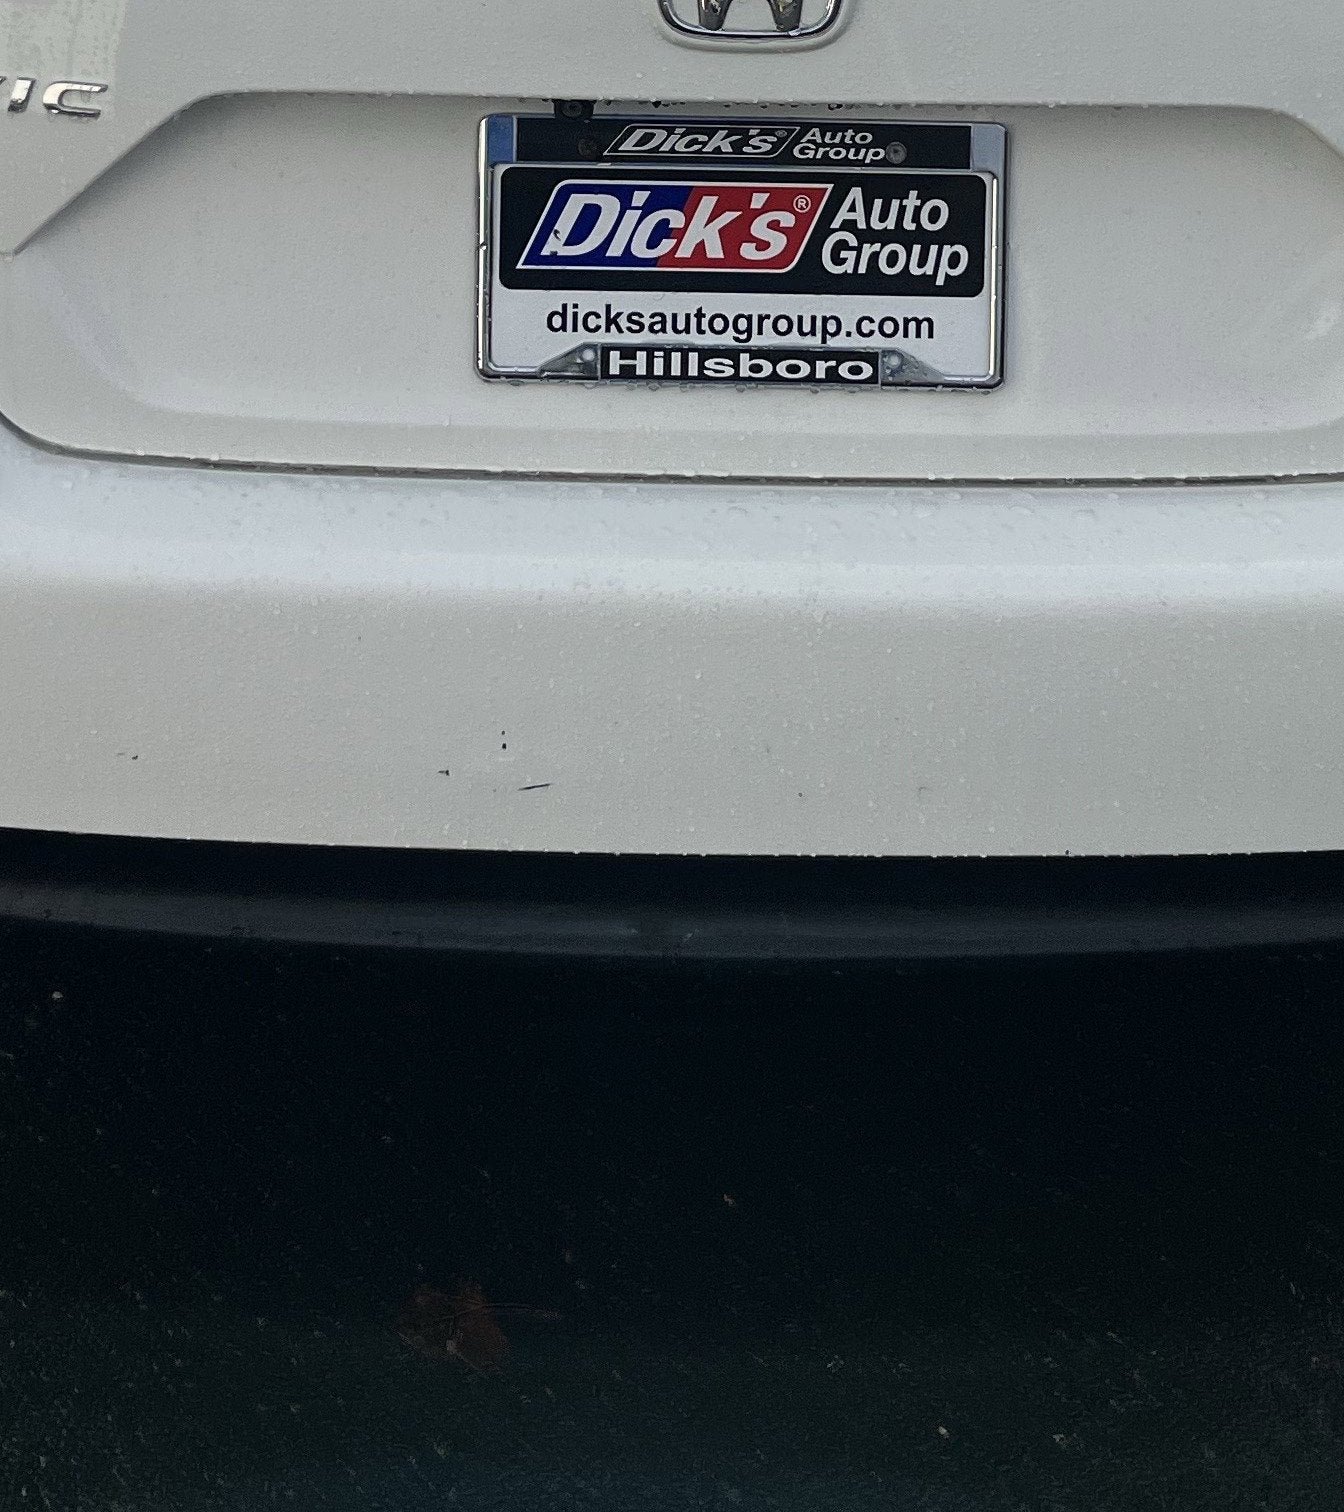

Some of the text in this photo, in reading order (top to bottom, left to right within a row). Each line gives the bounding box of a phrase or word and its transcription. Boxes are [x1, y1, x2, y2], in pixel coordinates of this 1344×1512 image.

[793, 143, 886, 163] Group
[800, 127, 873, 144] Auto
[831, 188, 948, 231] Auto
[821, 232, 969, 285] Group
[546, 303, 935, 344] dicksautogroup.com
[609, 351, 873, 380] Hillsboro
